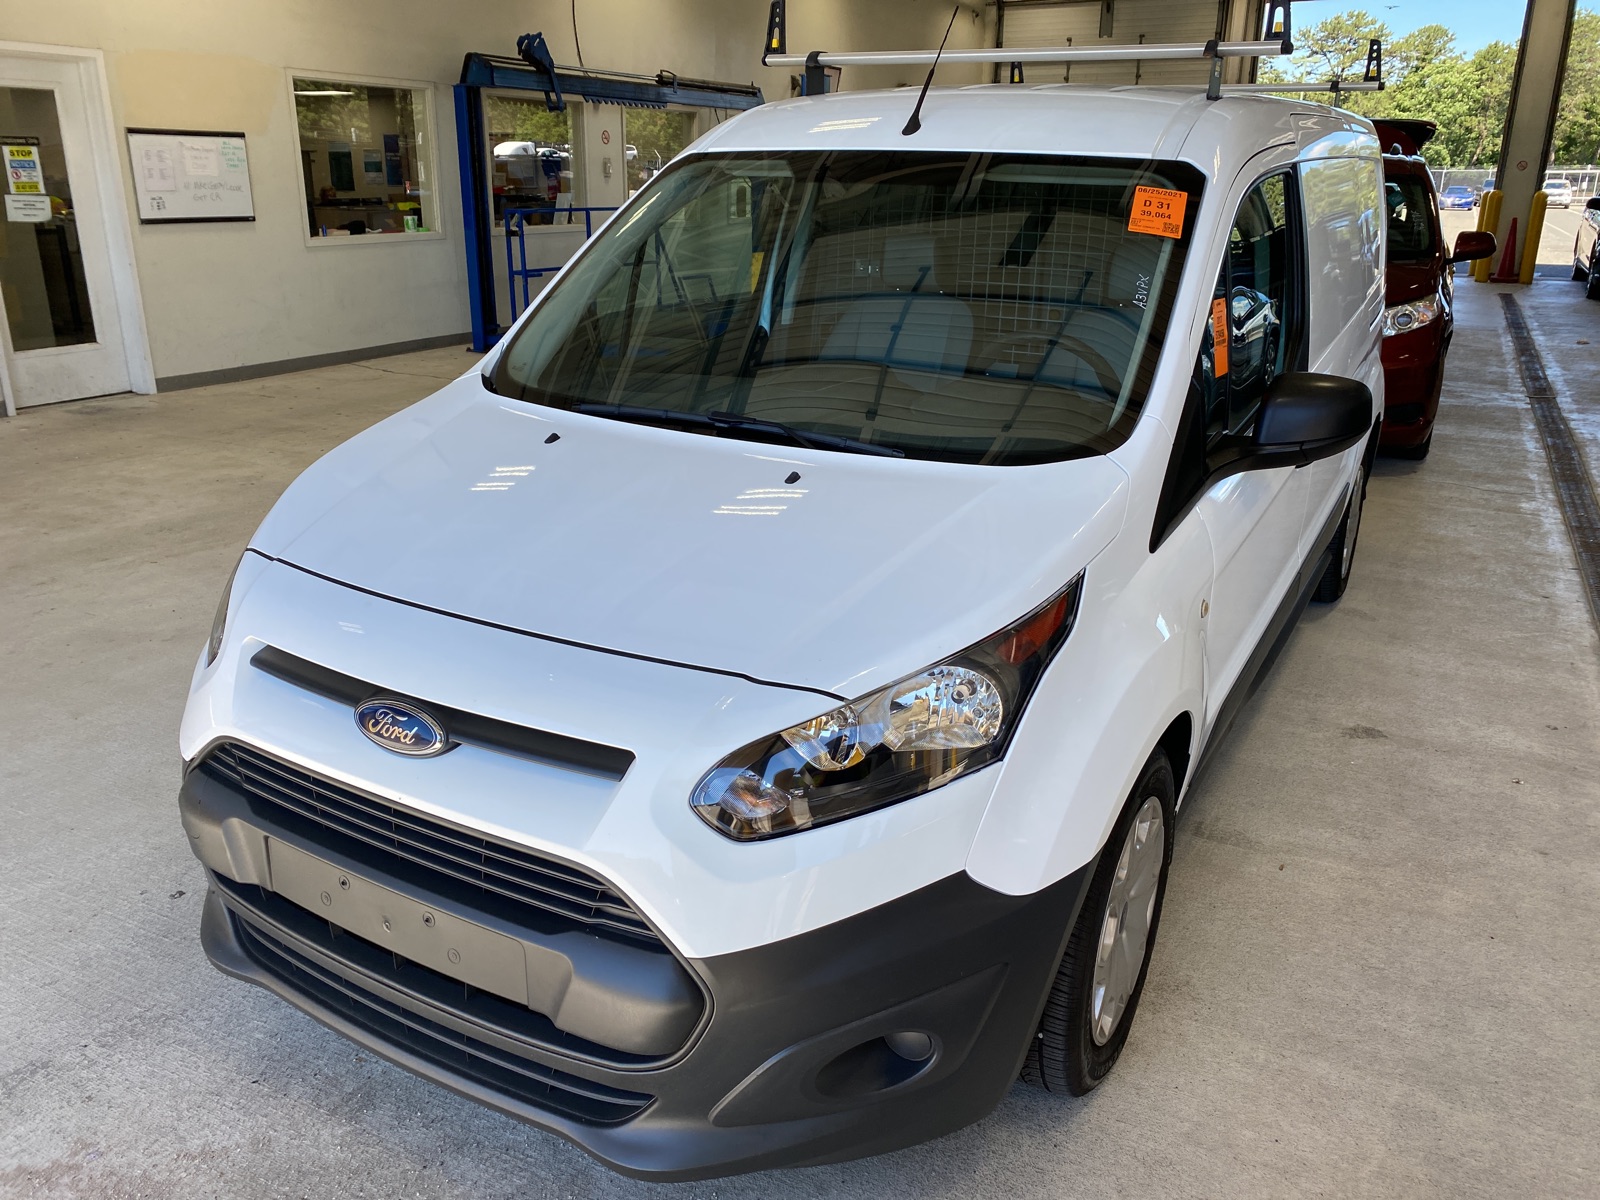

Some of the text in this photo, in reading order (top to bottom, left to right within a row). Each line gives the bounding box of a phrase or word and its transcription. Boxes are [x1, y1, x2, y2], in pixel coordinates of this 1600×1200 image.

[1143, 199, 1171, 210] D 31
[368, 708, 419, 744] Ford
